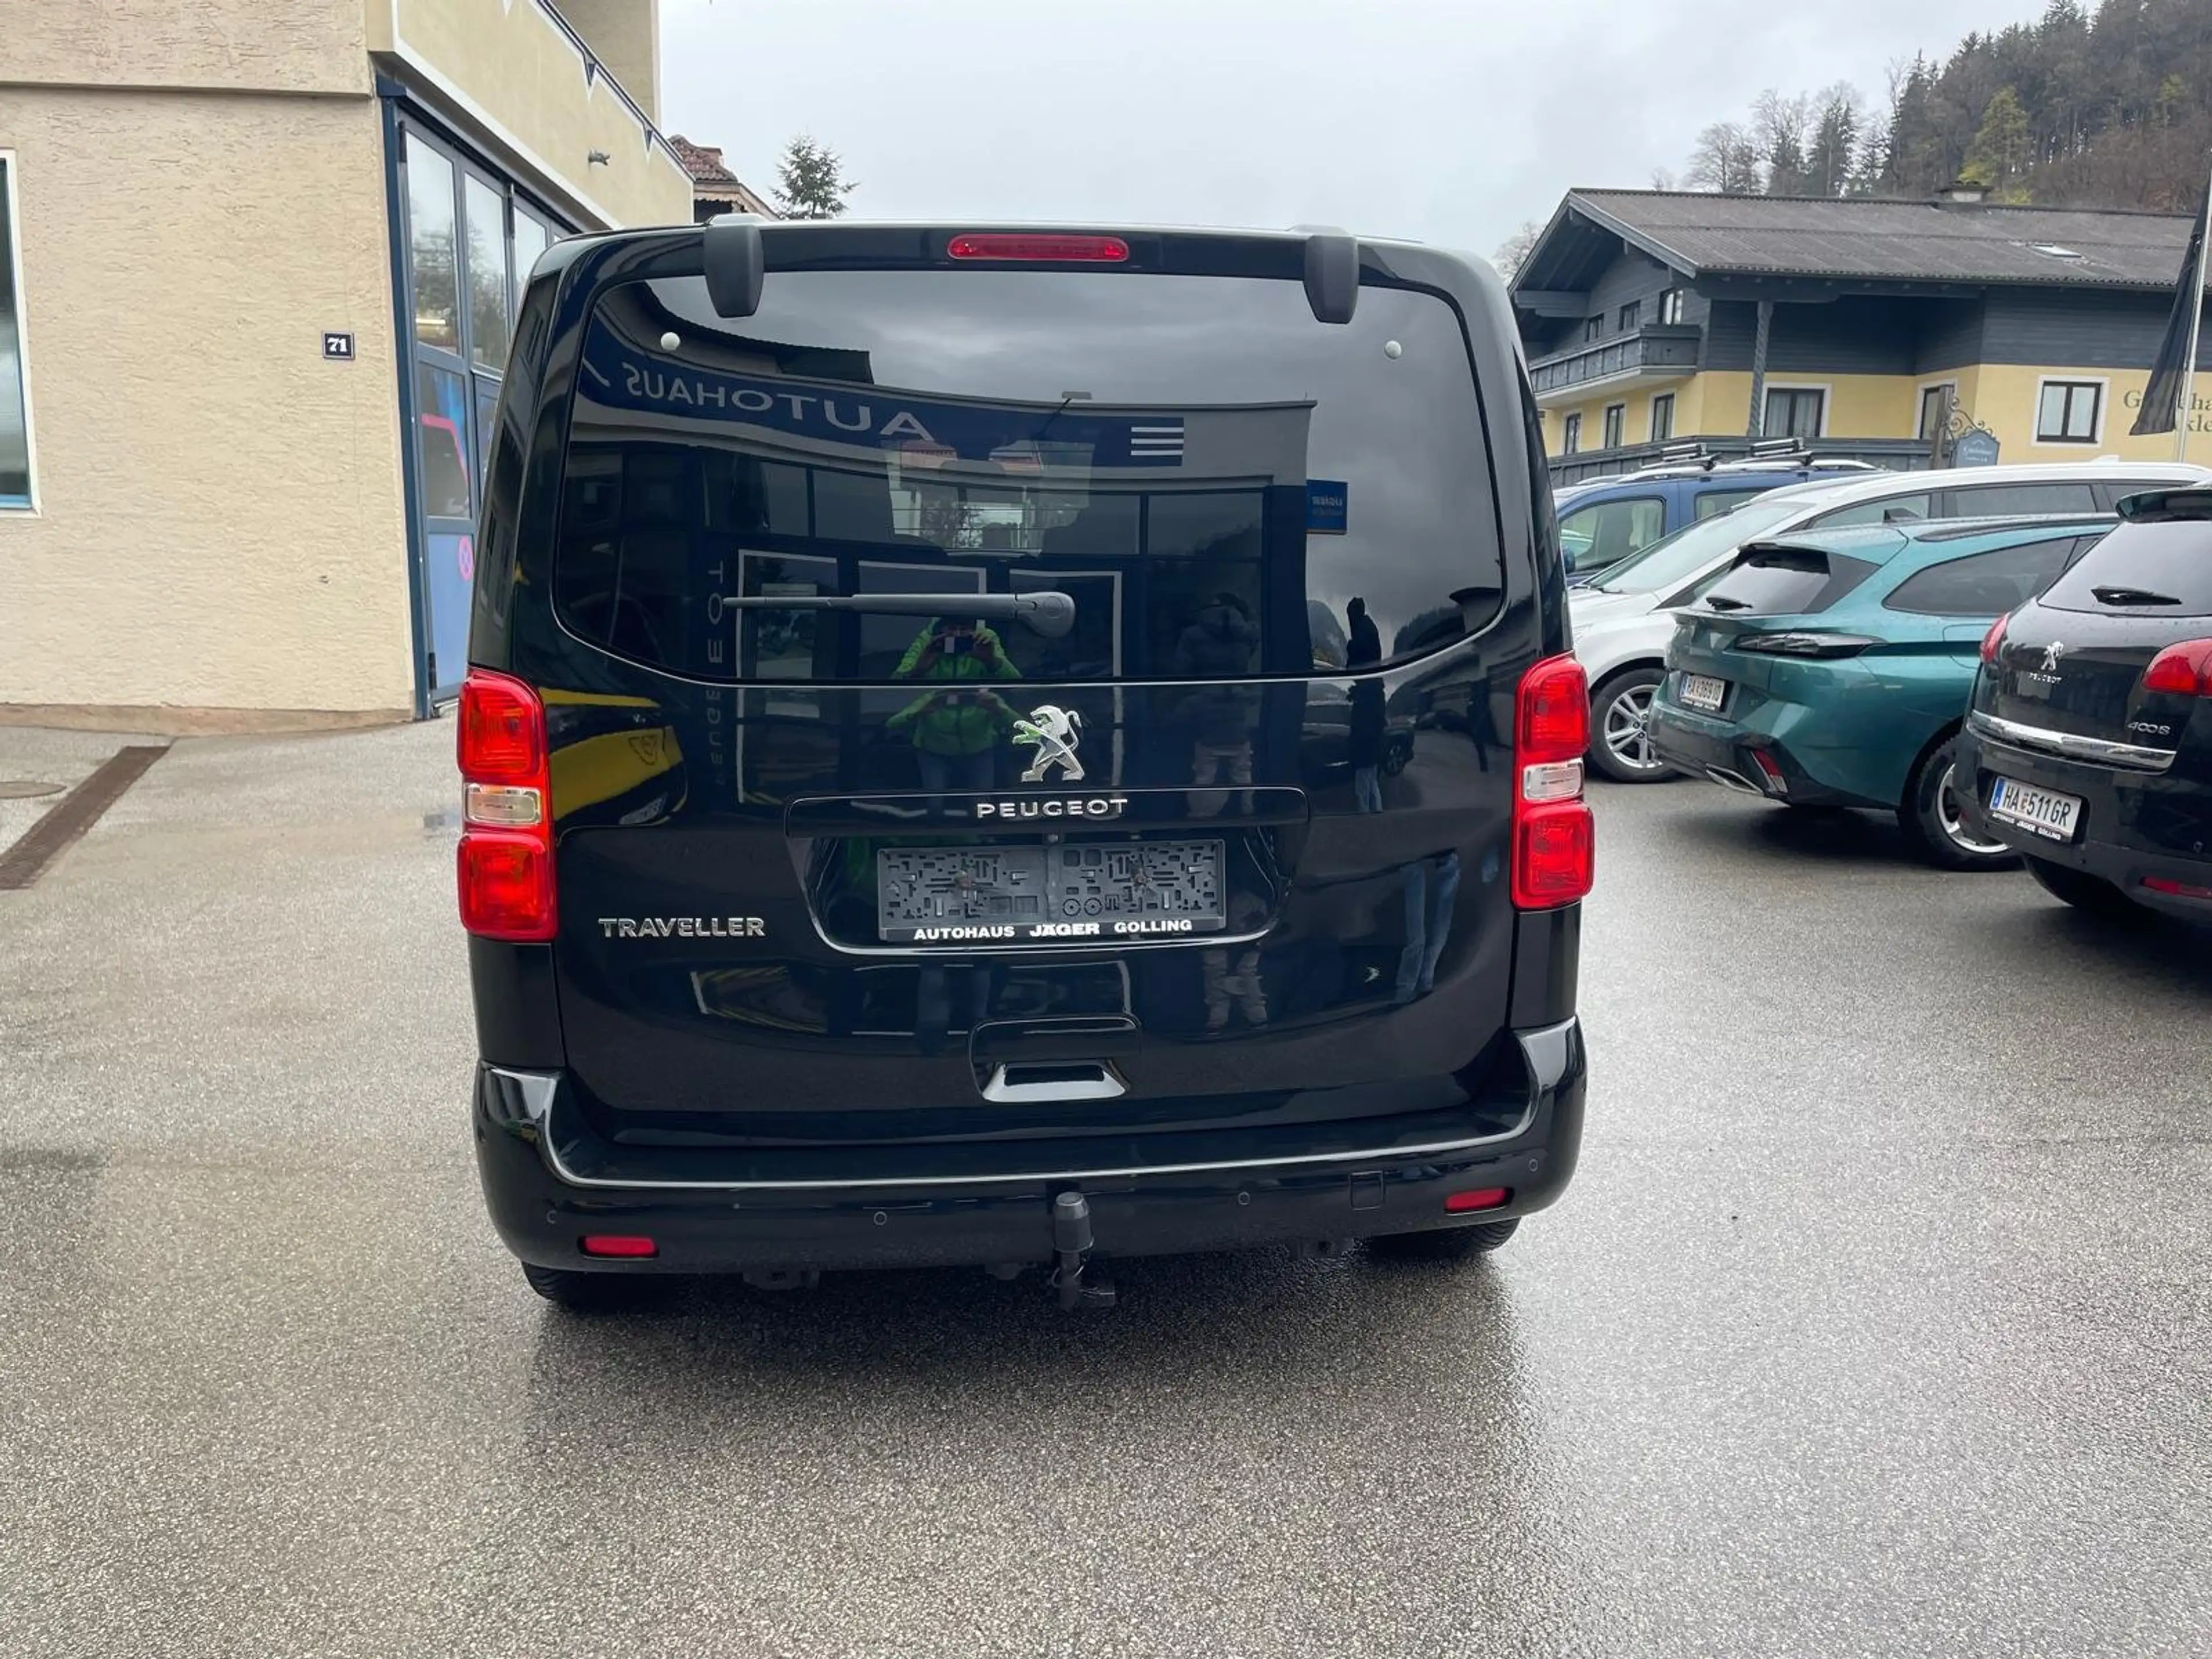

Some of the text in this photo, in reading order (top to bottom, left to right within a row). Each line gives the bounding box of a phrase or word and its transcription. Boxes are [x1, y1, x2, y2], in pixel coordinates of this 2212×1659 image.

[327, 337, 348, 352] 71
[977, 799, 1127, 818] PEUGEOT
[598, 918, 766, 938] TRAVELLER
[914, 919, 1193, 940] AUTOHAUS JÄGER GOLLING
